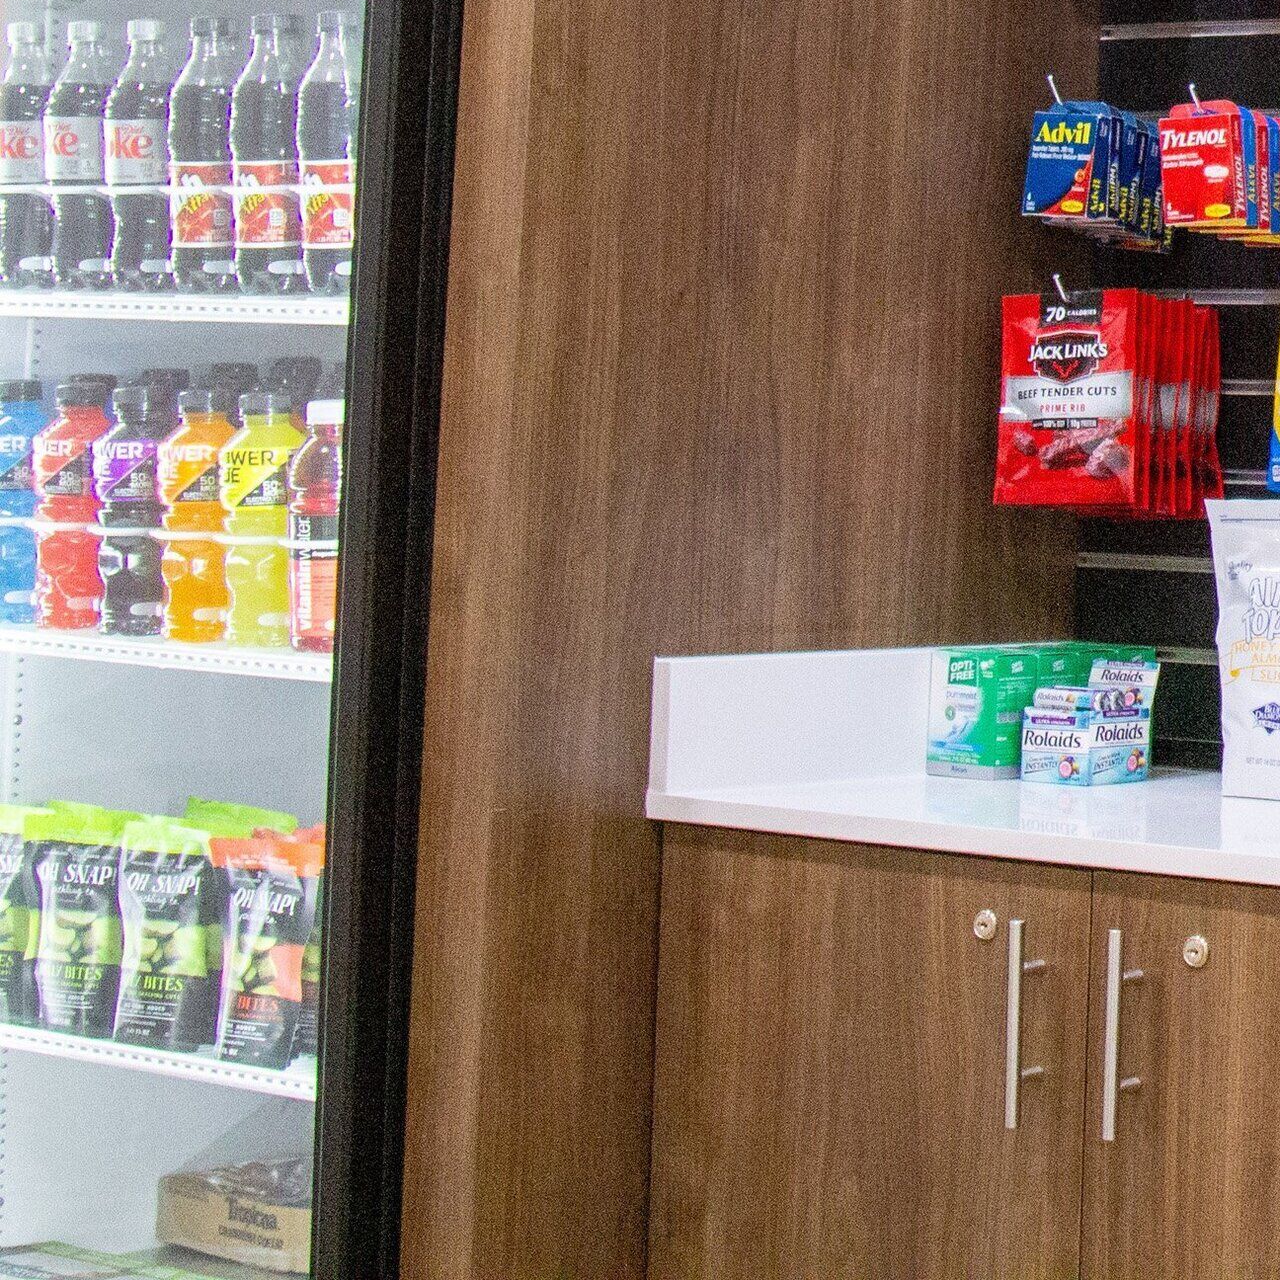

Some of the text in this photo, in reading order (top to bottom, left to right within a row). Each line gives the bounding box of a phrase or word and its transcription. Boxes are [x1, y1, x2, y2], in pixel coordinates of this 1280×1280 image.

[1035, 121, 1091, 144] Advil
[1161, 129, 1226, 149] TYLENOL
[1234, 155, 1245, 214] TYLENOL
[1259, 166, 1269, 221] TYLENOL
[1046, 307, 1066, 322] 70
[1028, 344, 1064, 362] JACK
[1018, 386, 1117, 401] BEEF TENDER CUTS
[1040, 404, 1086, 413] PRIME RIB
[1235, 642, 1276, 653] HONEY
[951, 659, 974, 671] OPTI-
[950, 671, 975, 682] FREE
[1101, 670, 1144, 683] Rolaids
[1024, 730, 1081, 748] Rolaids
[1095, 724, 1144, 743] Rolaids
[143, 976, 184, 992] BITES
